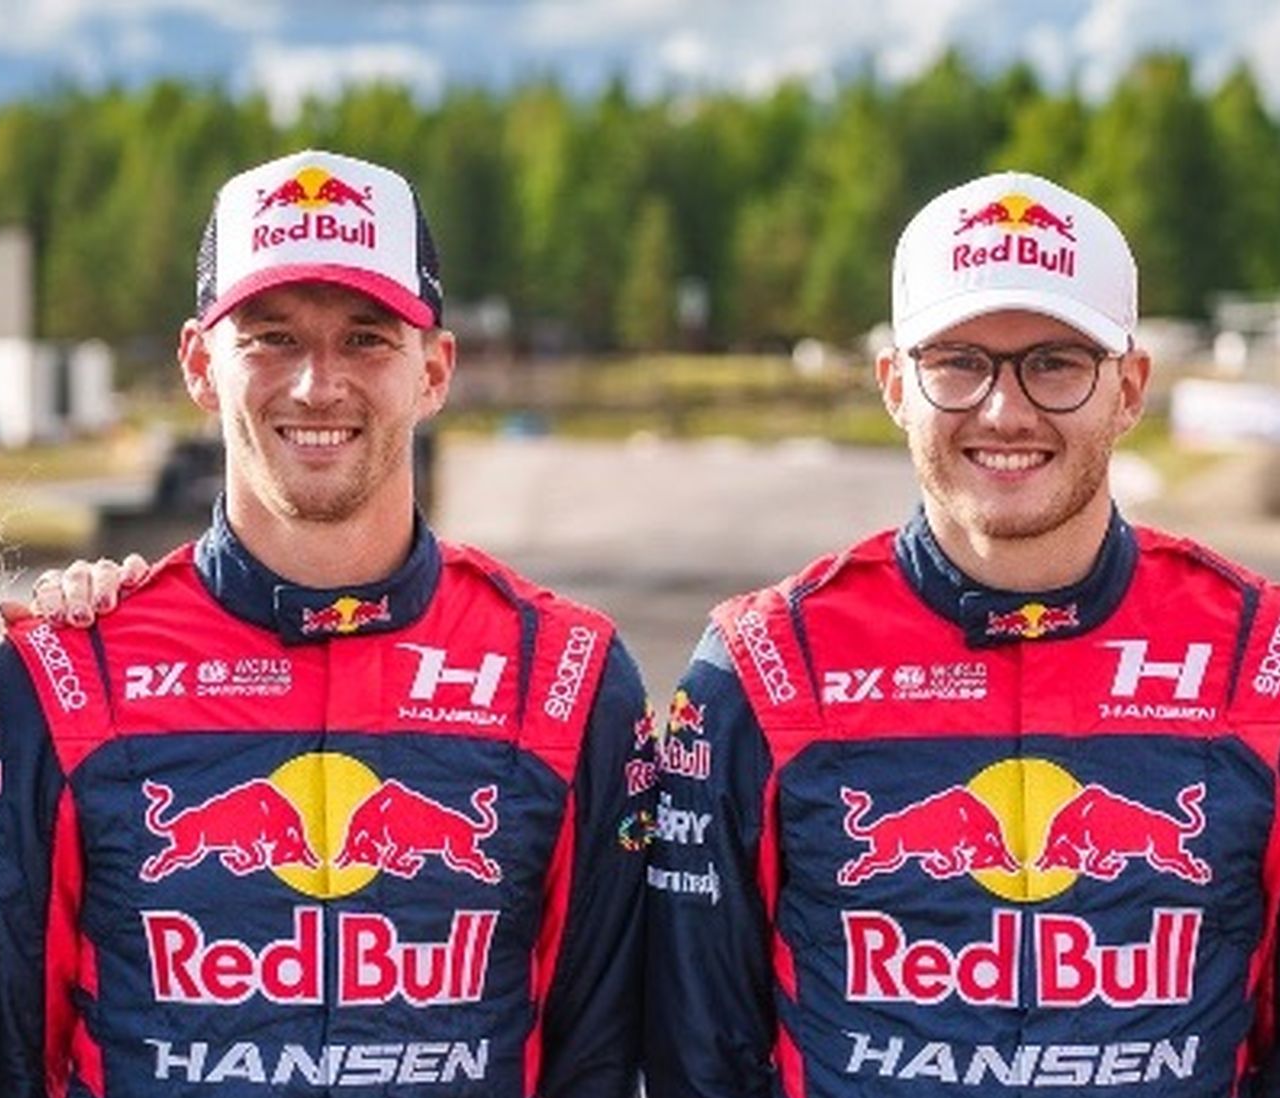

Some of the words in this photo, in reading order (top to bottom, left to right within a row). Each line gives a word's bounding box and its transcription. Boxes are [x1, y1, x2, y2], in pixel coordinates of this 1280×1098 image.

[252, 213, 308, 253] Red
[316, 215, 375, 249] Bull
[953, 235, 1011, 271] Red
[1018, 238, 1074, 277] Bull
[543, 626, 597, 723] sparco
[734, 608, 797, 706] sparco
[125, 661, 187, 700] RX
[824, 667, 884, 703] RX
[398, 705, 508, 726] HANSEN
[1098, 704, 1216, 721] HANSEN
[140, 905, 320, 1004] Red
[336, 908, 500, 1007] Bull
[841, 908, 1021, 1006] Red
[1034, 908, 1205, 1008] Bull
[145, 1038, 490, 1086] HANSEN
[842, 1031, 1200, 1087] HANSEN
